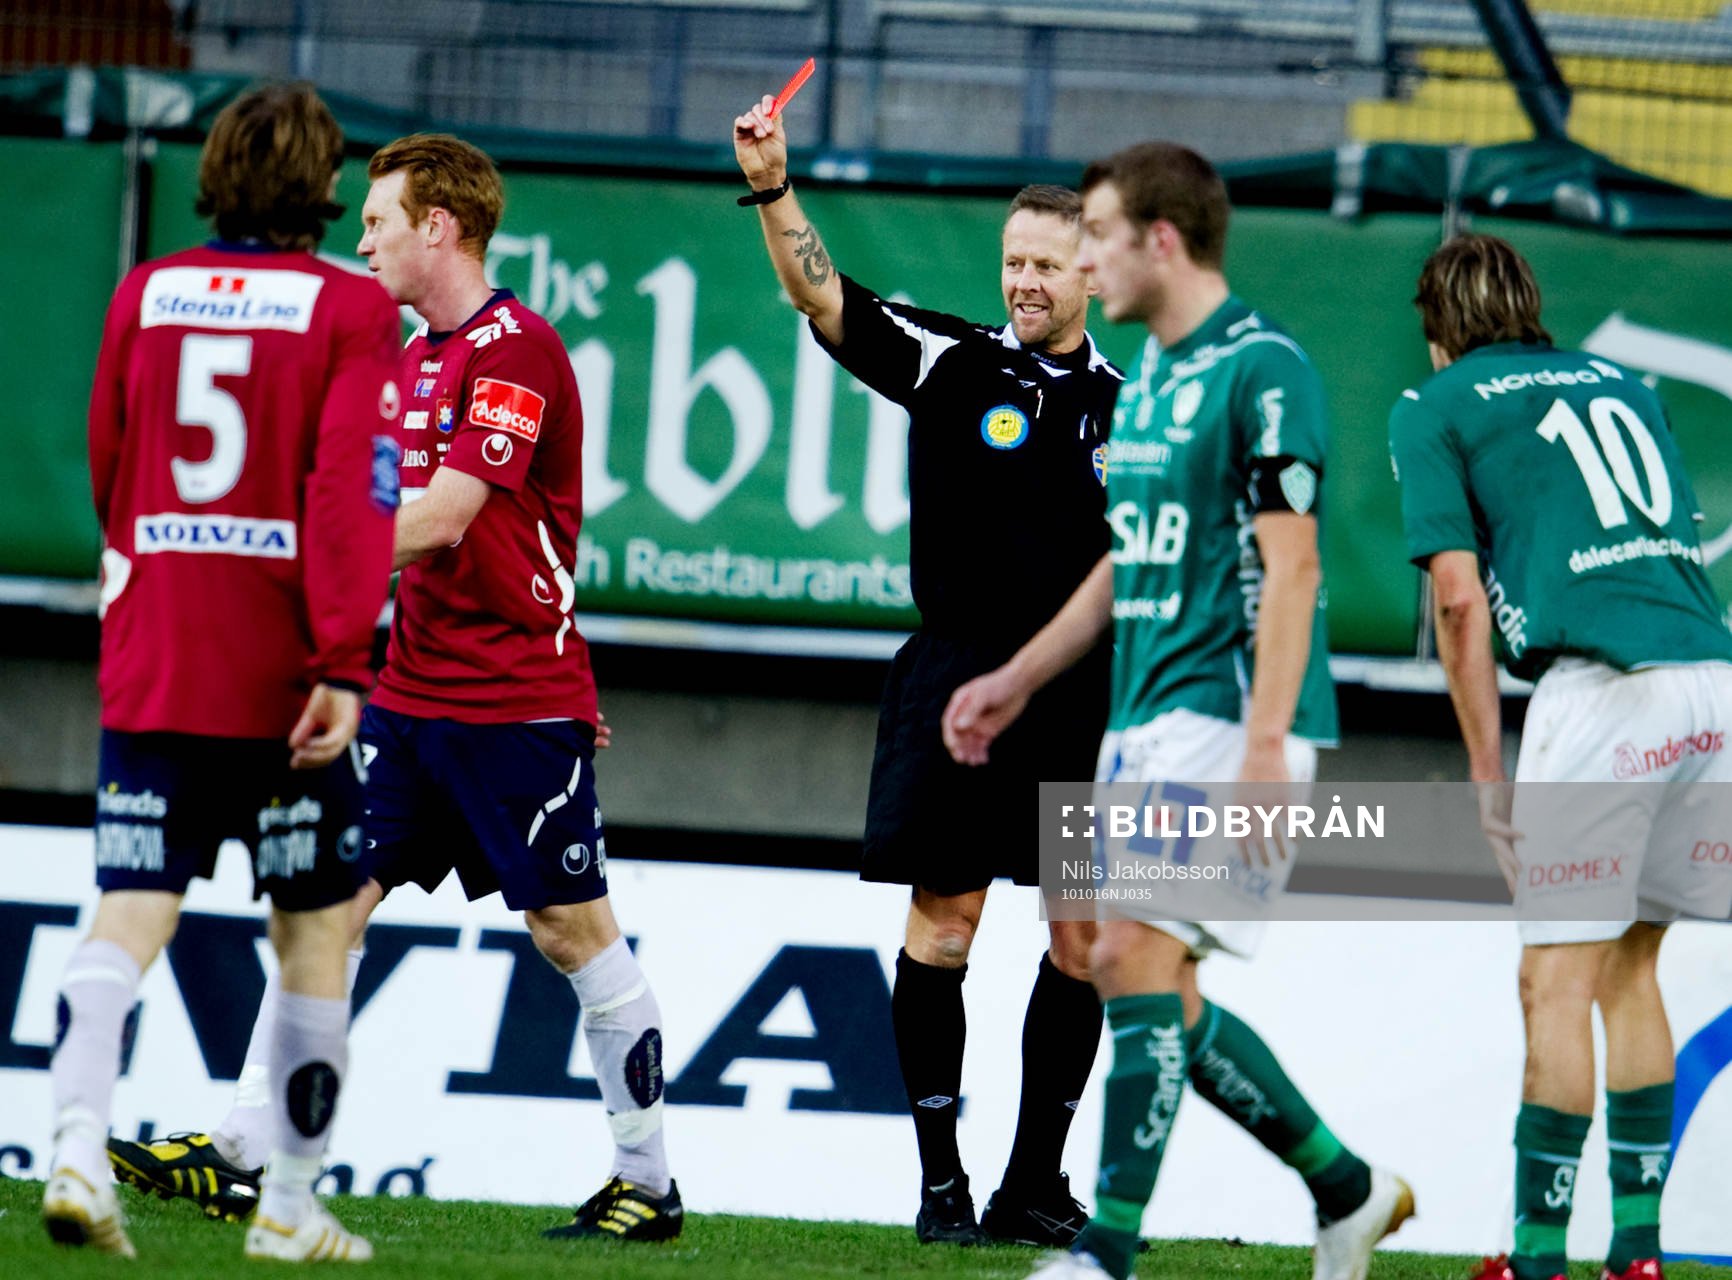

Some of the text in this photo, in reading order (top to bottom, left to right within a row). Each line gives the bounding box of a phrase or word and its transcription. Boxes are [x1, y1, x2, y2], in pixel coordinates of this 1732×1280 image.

[484, 232, 610, 328] The
[152, 294, 301, 322] Stena Line
[1473, 368, 1601, 401] Nordea
[170, 332, 254, 504] 5
[475, 401, 537, 435] Adecco
[1535, 396, 1673, 530] 10
[144, 523, 289, 552] VOLVIA
[624, 537, 912, 608] Restaurants
[1528, 855, 1623, 888] DOMEX
[0, 899, 966, 1116] LVIA
